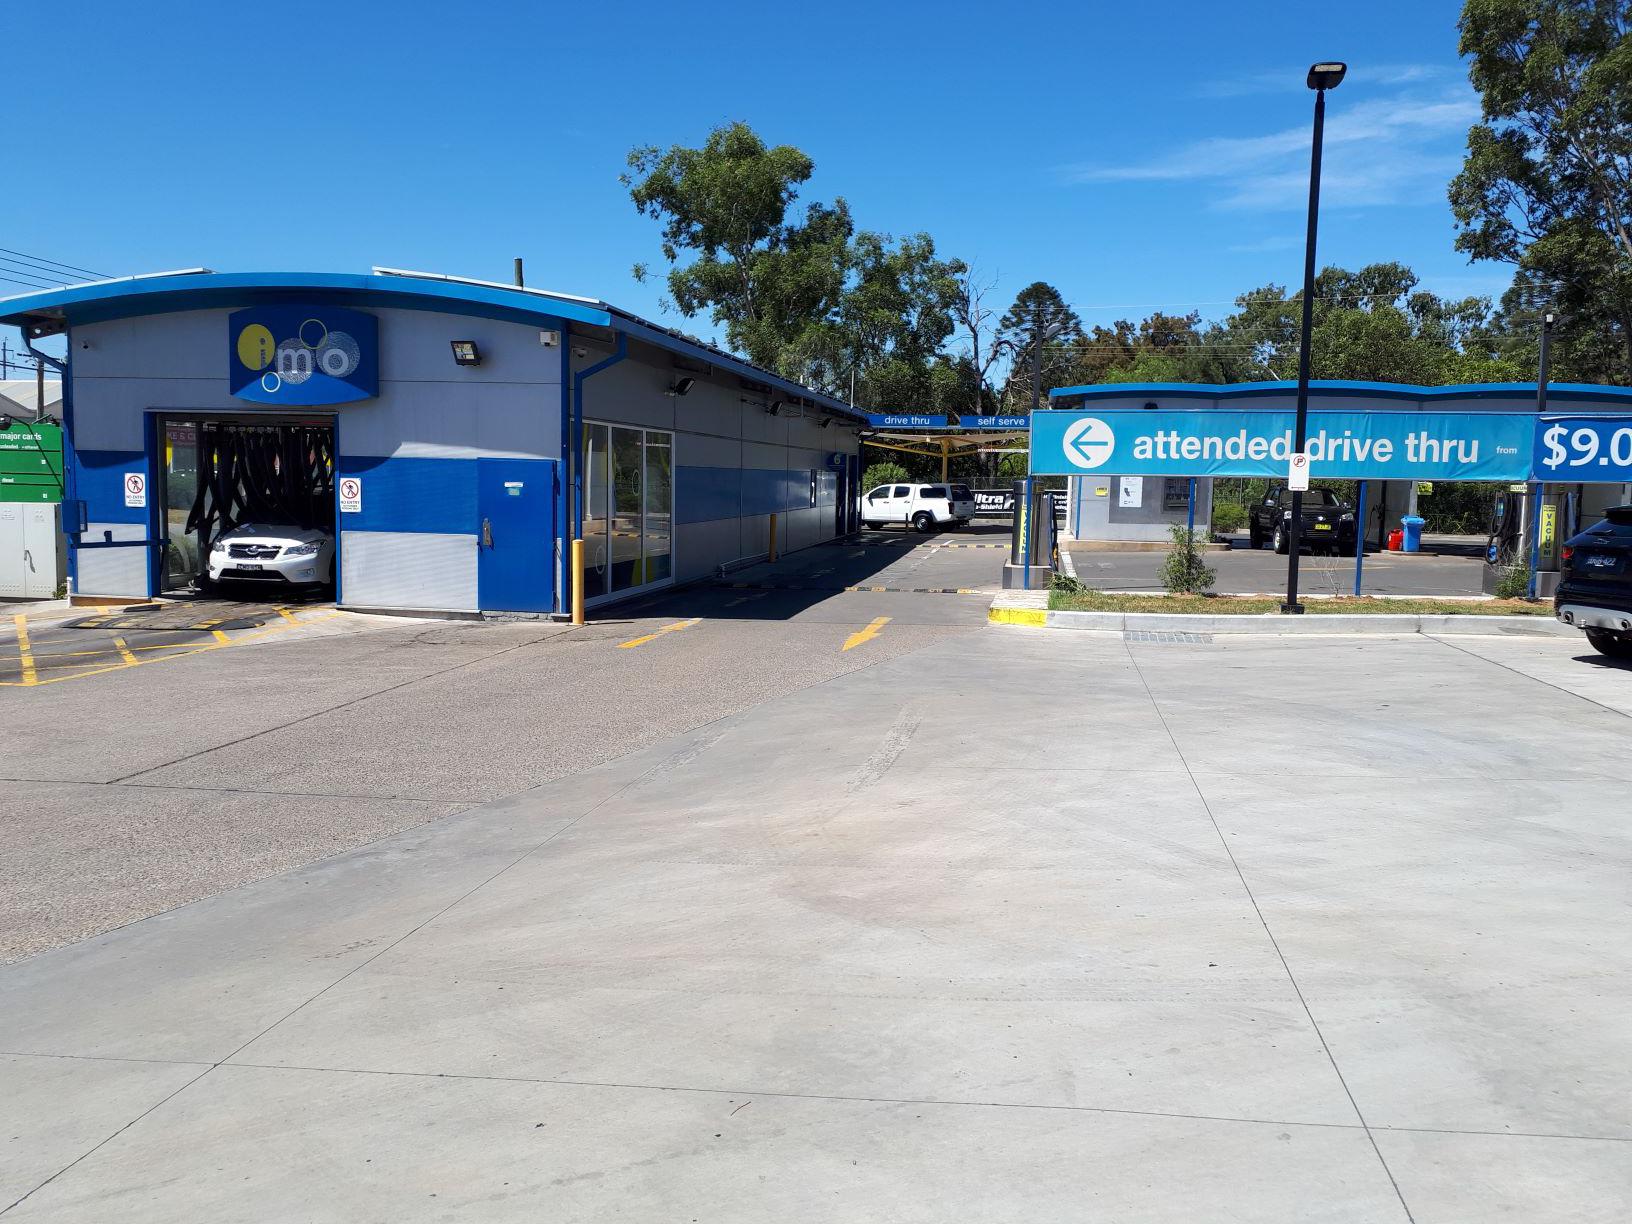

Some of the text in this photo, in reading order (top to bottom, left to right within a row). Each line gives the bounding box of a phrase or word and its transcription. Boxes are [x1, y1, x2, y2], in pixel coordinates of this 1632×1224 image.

[260, 337, 349, 375] imo
[884, 415, 930, 425] drive thru
[977, 416, 1025, 426] self serve
[1133, 429, 1518, 464] attended drive thru from
[1542, 423, 1632, 471] $9.0
[1544, 513, 1553, 557] VACUUM
